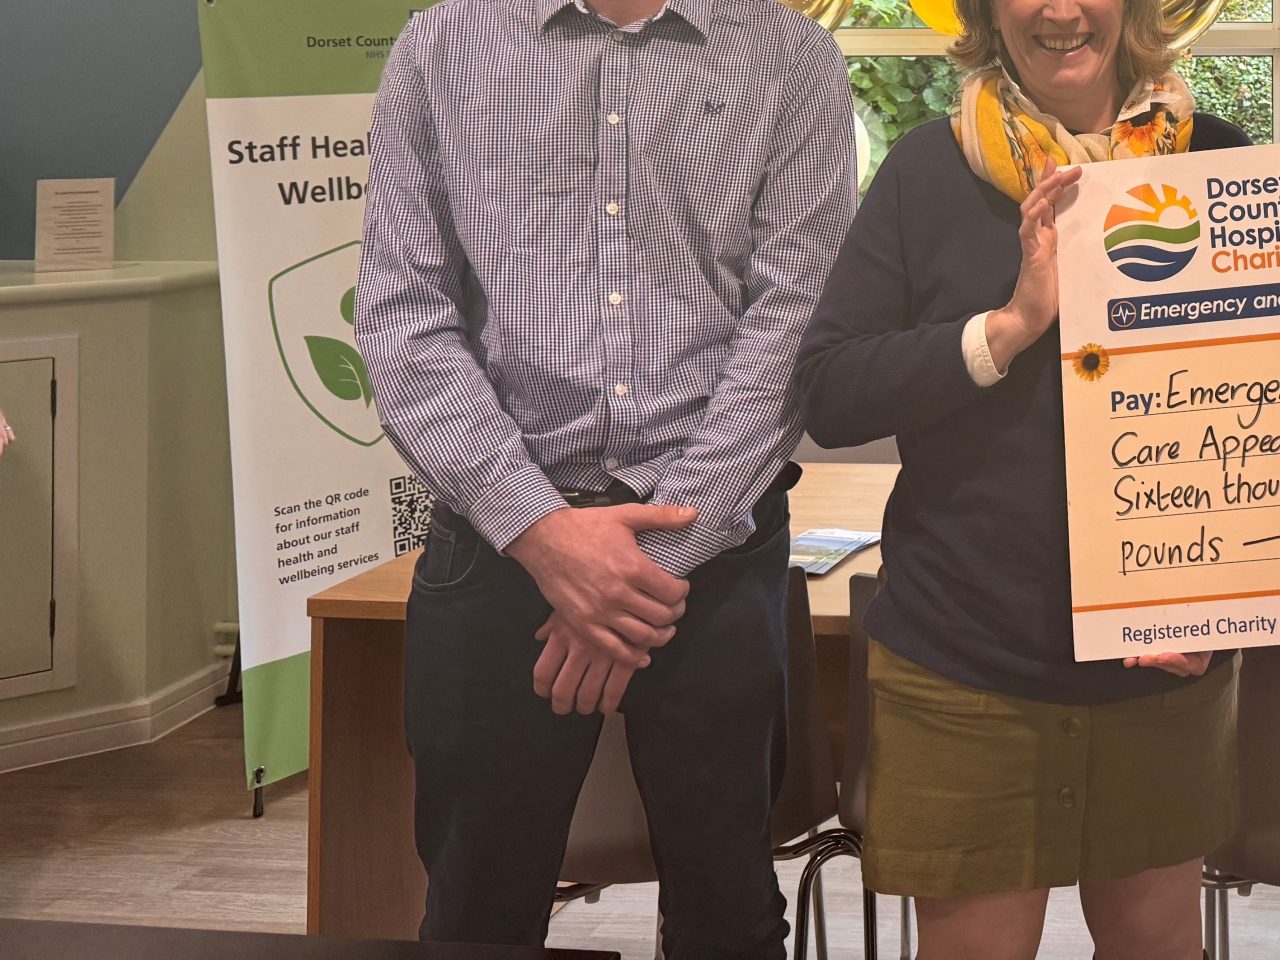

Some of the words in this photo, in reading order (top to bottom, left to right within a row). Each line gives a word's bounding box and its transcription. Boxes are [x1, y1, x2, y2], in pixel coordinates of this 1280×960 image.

[307, 37, 352, 47] Dorset
[355, 35, 398, 48] Count
[228, 135, 300, 165] Staff
[1140, 293, 1247, 322] Emergency
[1110, 389, 1161, 414] Pay:
[1112, 431, 1180, 469] Care
[274, 504, 300, 516] Scan
[304, 499, 321, 510] the
[325, 493, 341, 504] QR
[344, 488, 369, 500] code
[1115, 477, 1211, 517] Sixteen
[275, 522, 292, 534] for
[295, 507, 360, 529] information
[276, 536, 309, 550] about
[313, 530, 331, 541] our
[334, 522, 359, 536] staff
[277, 552, 313, 568] health
[317, 545, 337, 558] and
[1121, 526, 1223, 576] pounds
[278, 565, 334, 584] wellbeing
[337, 552, 379, 570] services
[1122, 621, 1211, 644] Registered
[1215, 613, 1277, 637] Charity
